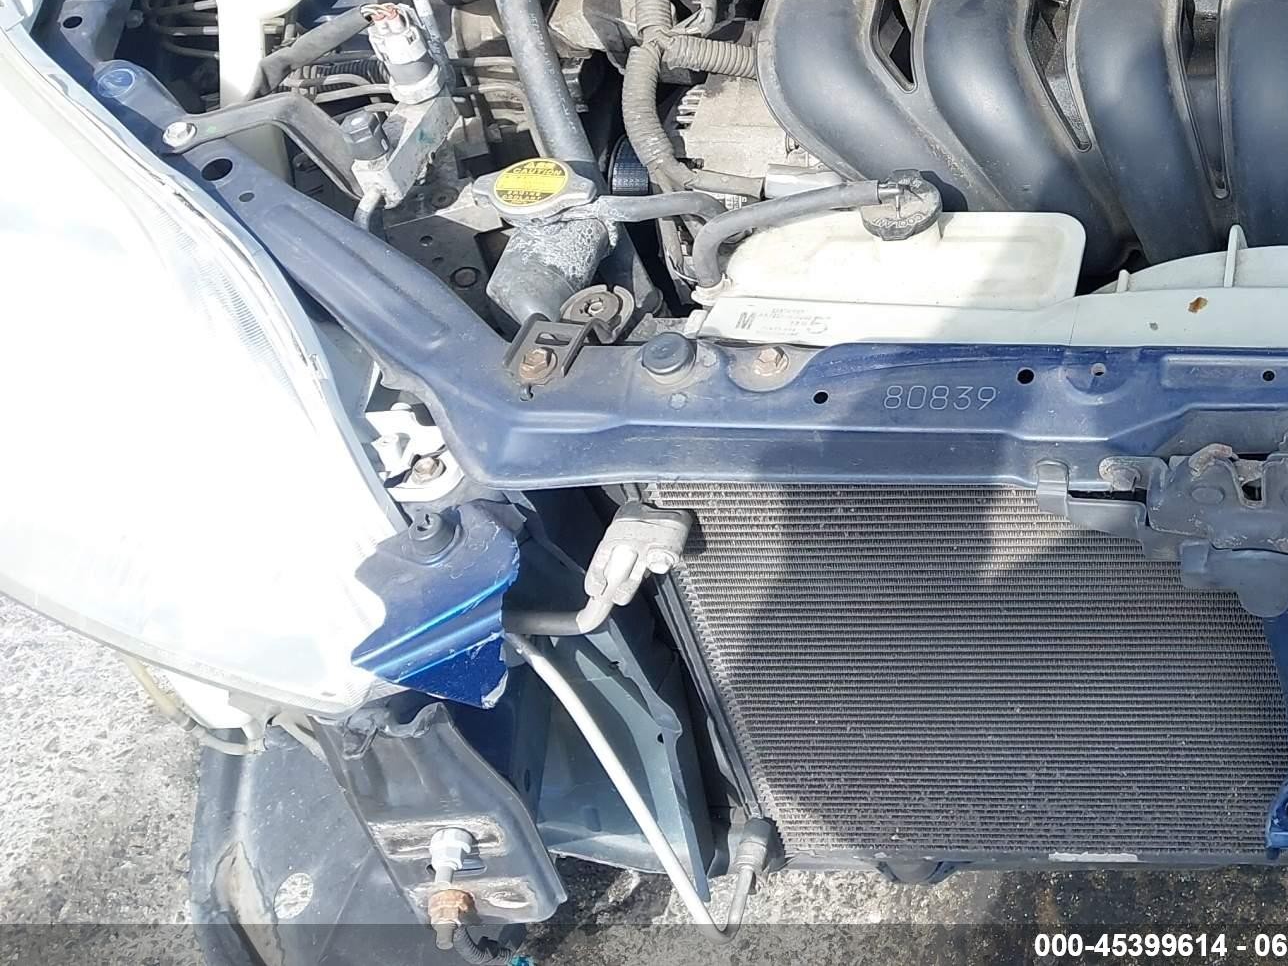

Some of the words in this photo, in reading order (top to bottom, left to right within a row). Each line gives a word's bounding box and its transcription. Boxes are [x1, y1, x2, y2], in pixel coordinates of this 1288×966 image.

[512, 167, 562, 177] CAUTION
[872, 213, 926, 229] COOLANT
[883, 385, 997, 411] 80839
